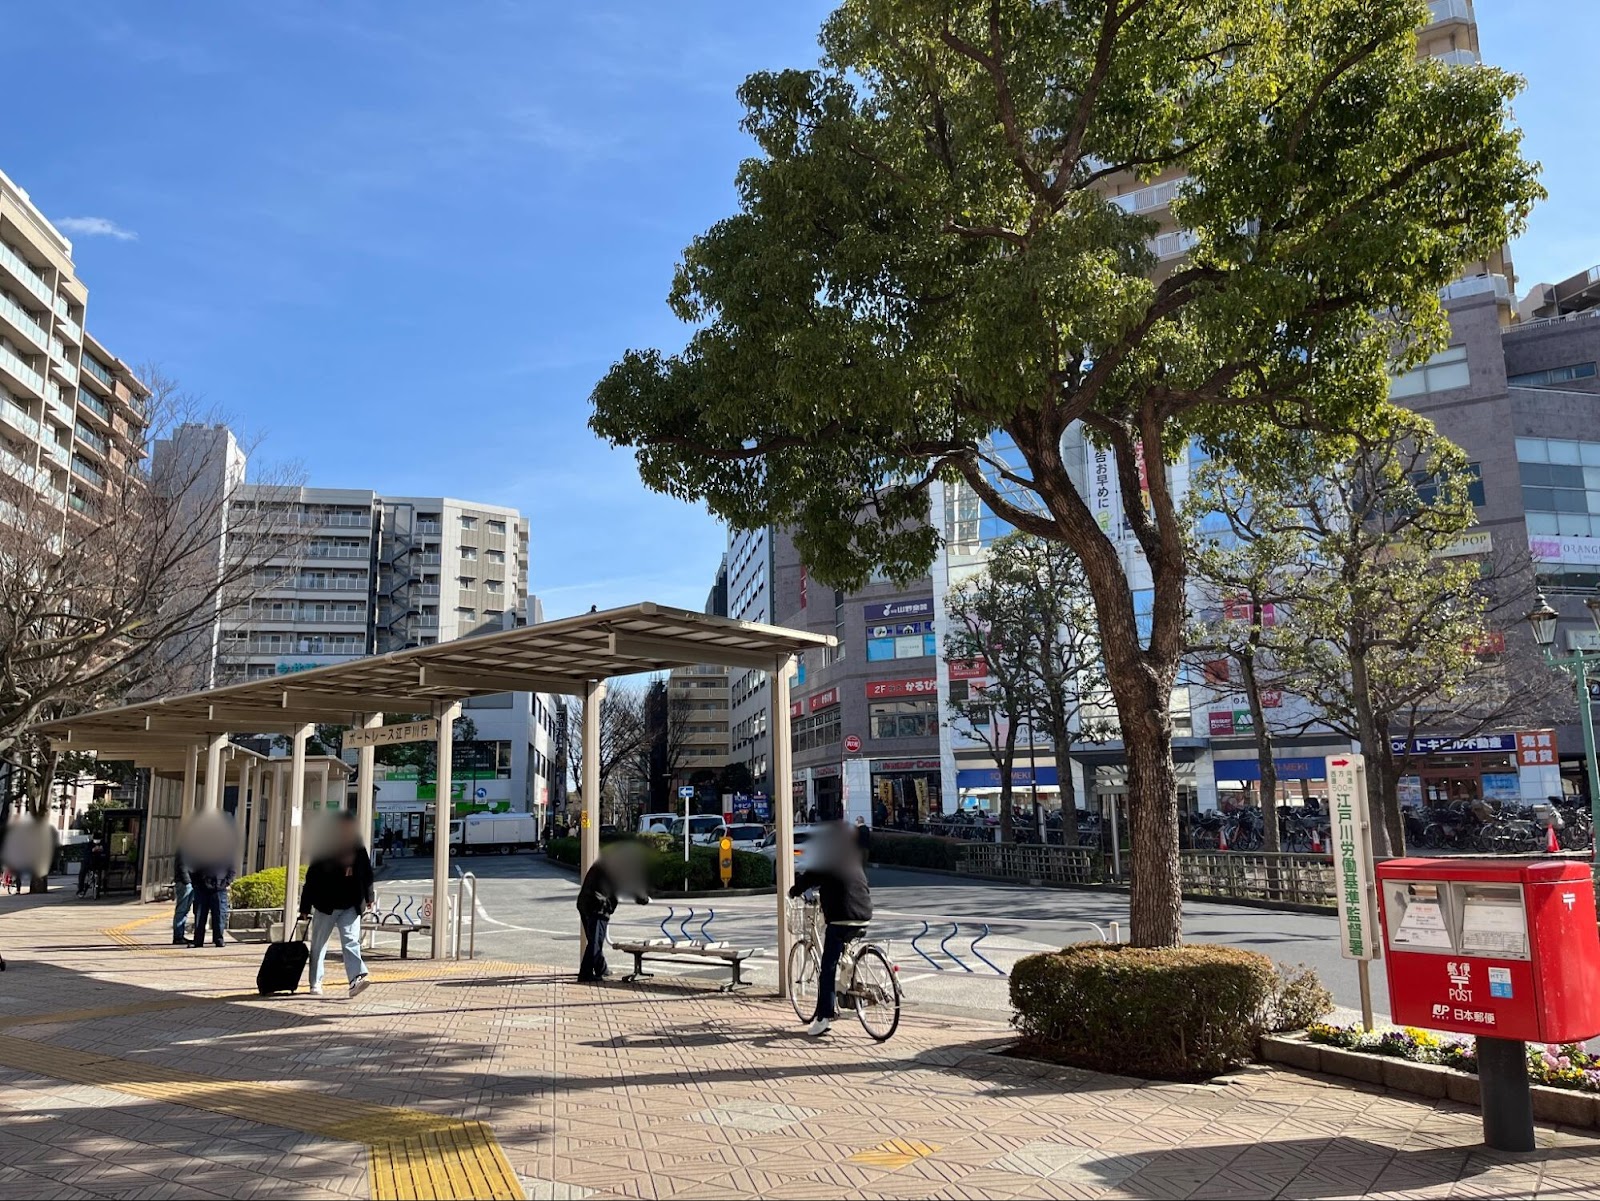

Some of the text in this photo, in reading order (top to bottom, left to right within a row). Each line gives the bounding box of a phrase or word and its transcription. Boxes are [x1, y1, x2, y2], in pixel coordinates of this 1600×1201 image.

[1563, 544, 1600, 554] ORANG
[874, 685, 886, 694] 2F
[348, 724, 428, 745] ボートレース江戸川行
[1521, 735, 1552, 747] 売買
[1522, 750, 1553, 763] 賃貸
[1336, 793, 1364, 956] 江戸川労働基準監督署
[1446, 962, 1471, 977] 郵便
[1448, 988, 1473, 1002] POST
[1453, 1009, 1496, 1025] 日本郵便
